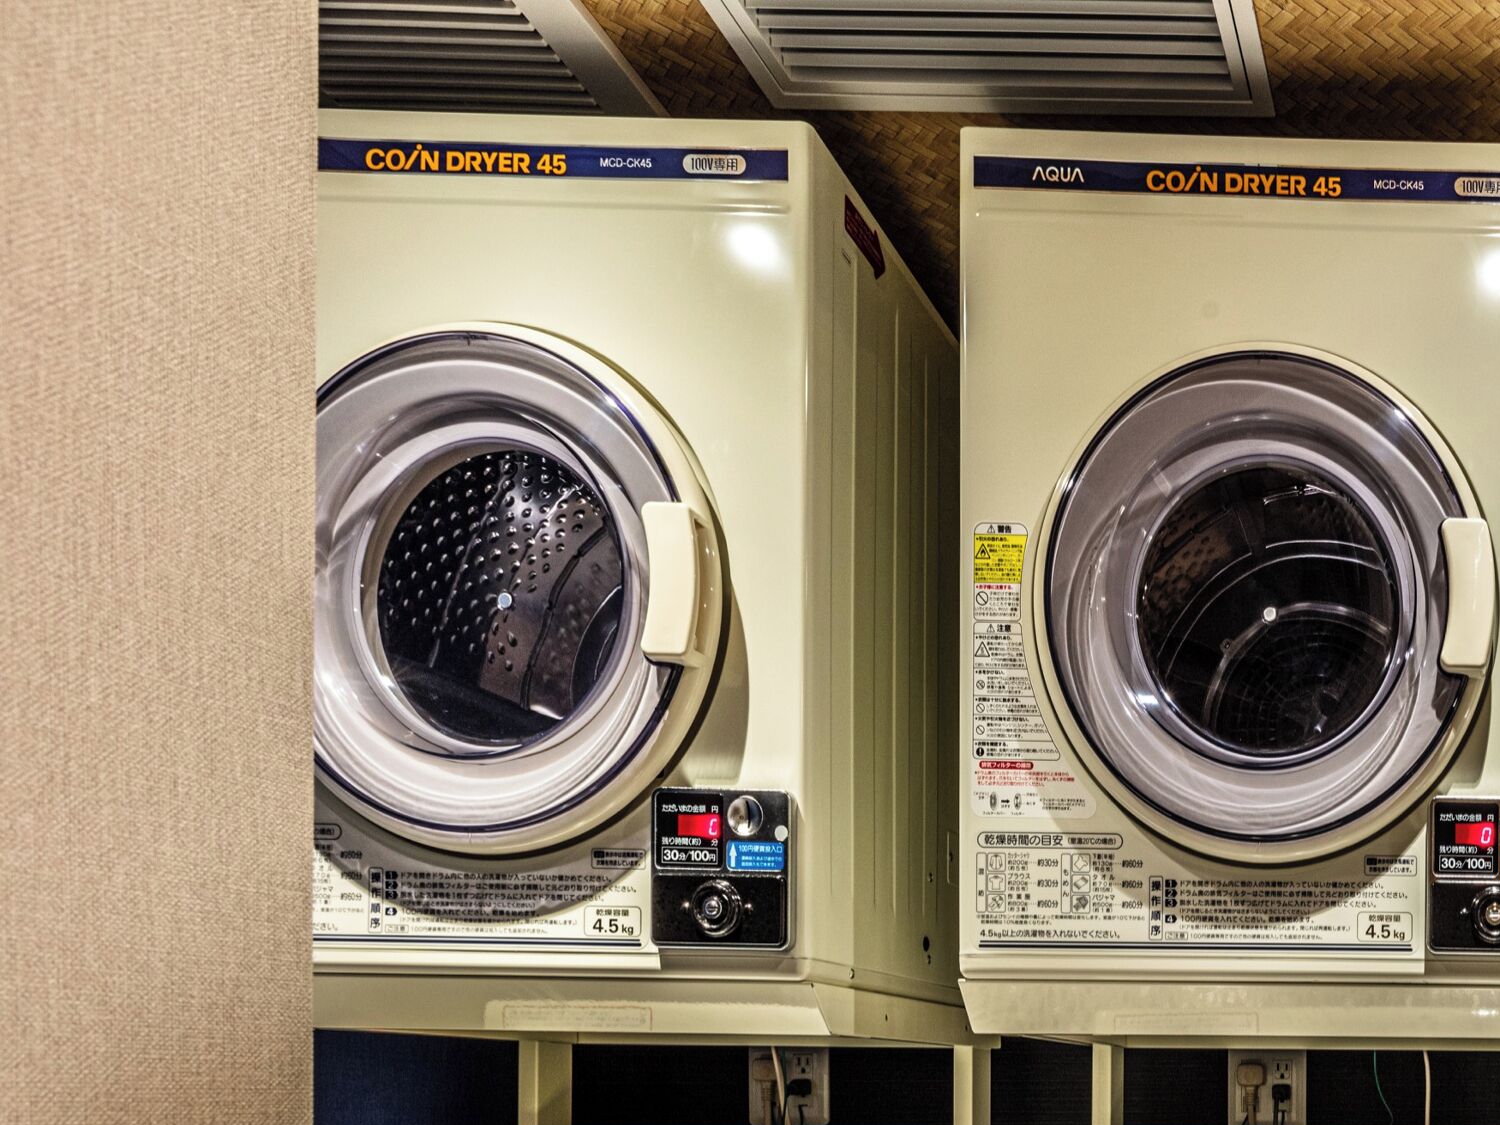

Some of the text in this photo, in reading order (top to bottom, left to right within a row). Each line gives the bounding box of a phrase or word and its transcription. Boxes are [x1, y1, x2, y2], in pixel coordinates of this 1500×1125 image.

[446, 150, 530, 175] DRYER
[537, 153, 566, 175] 45
[599, 157, 652, 170] MCD-CK45
[690, 156, 739, 173] 100V専用
[1032, 166, 1085, 183] AQUA
[1225, 172, 1306, 196] DRYER
[1313, 176, 1342, 198] 45
[1373, 179, 1424, 191] MCD-CK45
[711, 805, 719, 813] 円
[984, 835, 1063, 845] 乾燥時間の目安
[1481, 828, 1491, 844] 0
[664, 850, 716, 861] 30分/100円
[1038, 859, 1058, 867] 約30分
[1122, 860, 1143, 868] 約60分
[1442, 858, 1491, 869] 30分/100円
[1122, 880, 1142, 888] 約60分
[1038, 900, 1058, 908] 約60分
[1122, 901, 1142, 909] 約60分
[596, 909, 629, 917] 乾燥容量
[1369, 914, 1401, 922] 乾燥容量
[593, 919, 619, 934] 4.5
[621, 924, 634, 936] kg
[1366, 924, 1406, 940] 4.5 kg
[980, 930, 1120, 938] 4.5kg以上の洗濯物を入れないでください。
